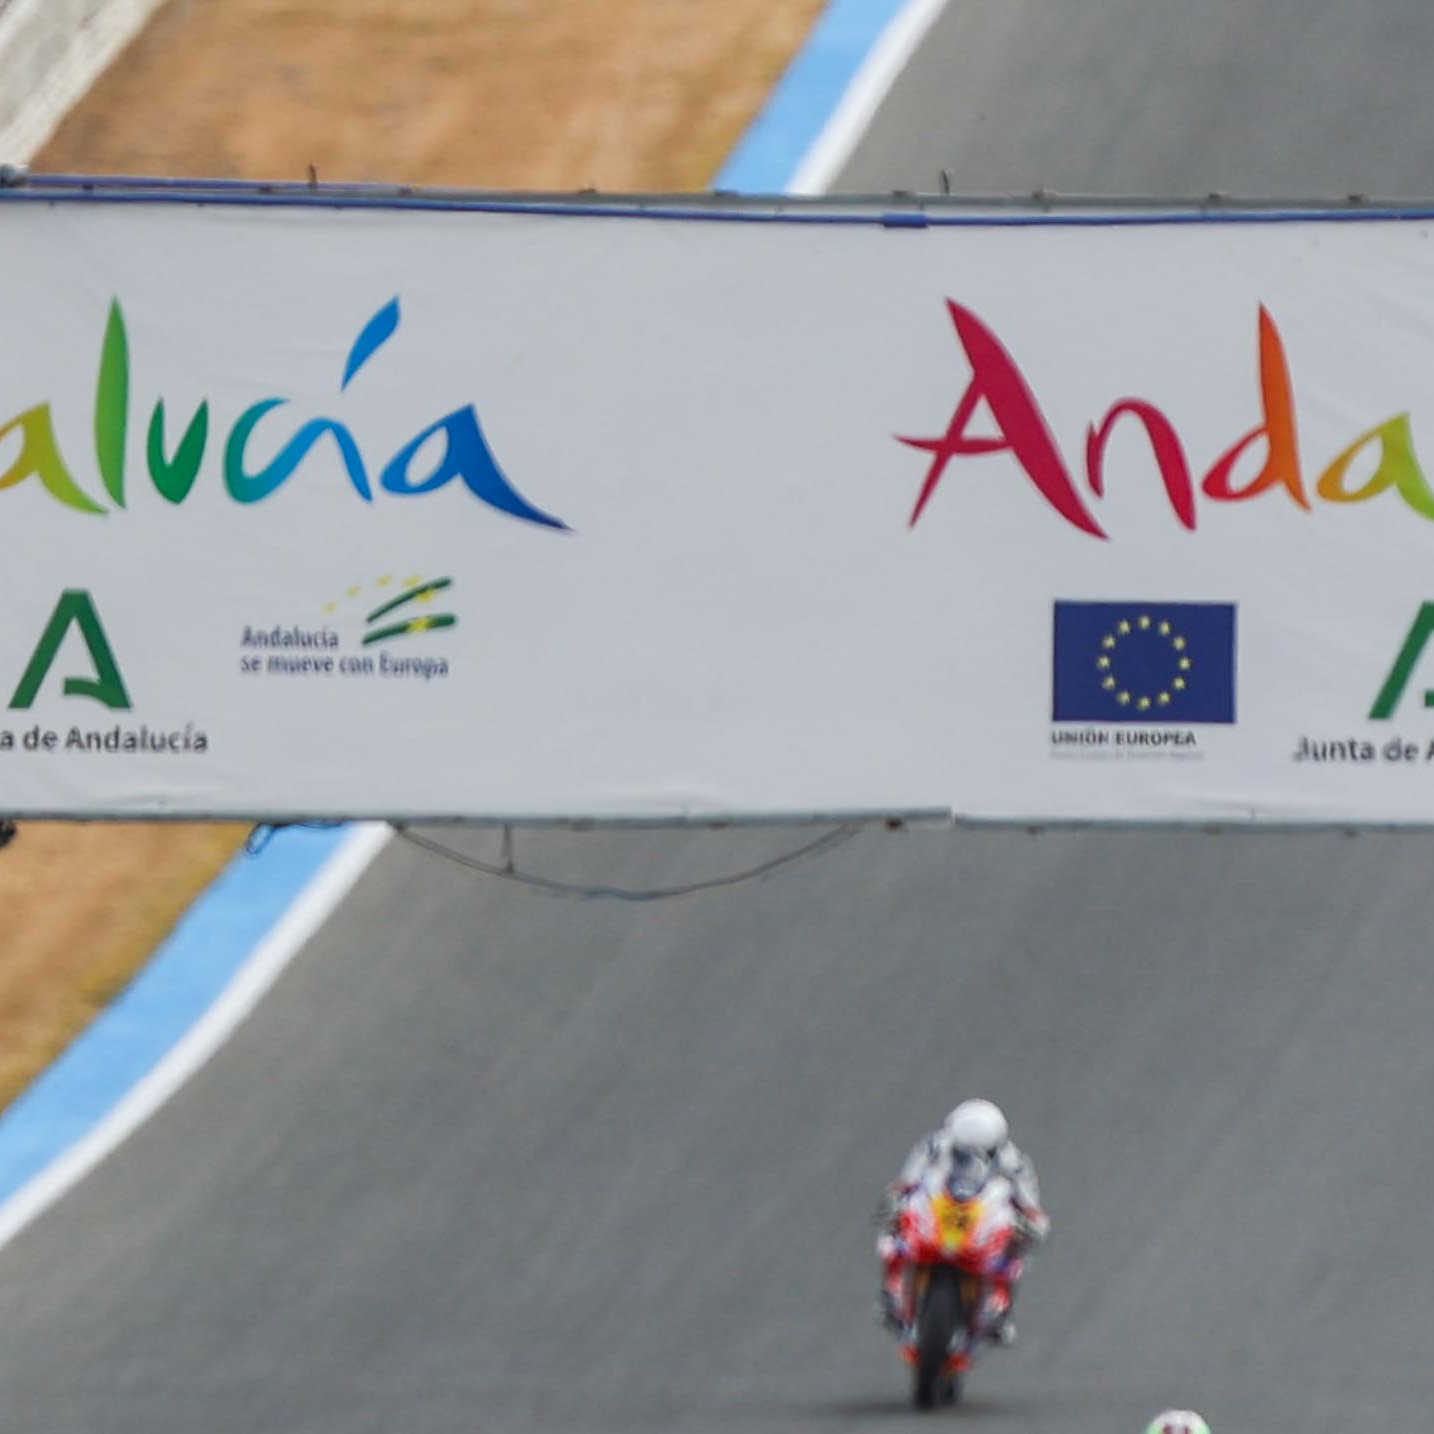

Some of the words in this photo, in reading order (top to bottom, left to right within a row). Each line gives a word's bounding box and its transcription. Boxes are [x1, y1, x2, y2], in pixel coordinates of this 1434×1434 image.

[22, 724, 58, 751] de
[62, 724, 211, 753] Andalucía
[1294, 737, 1375, 762] Junta
[1382, 738, 1419, 762] de
